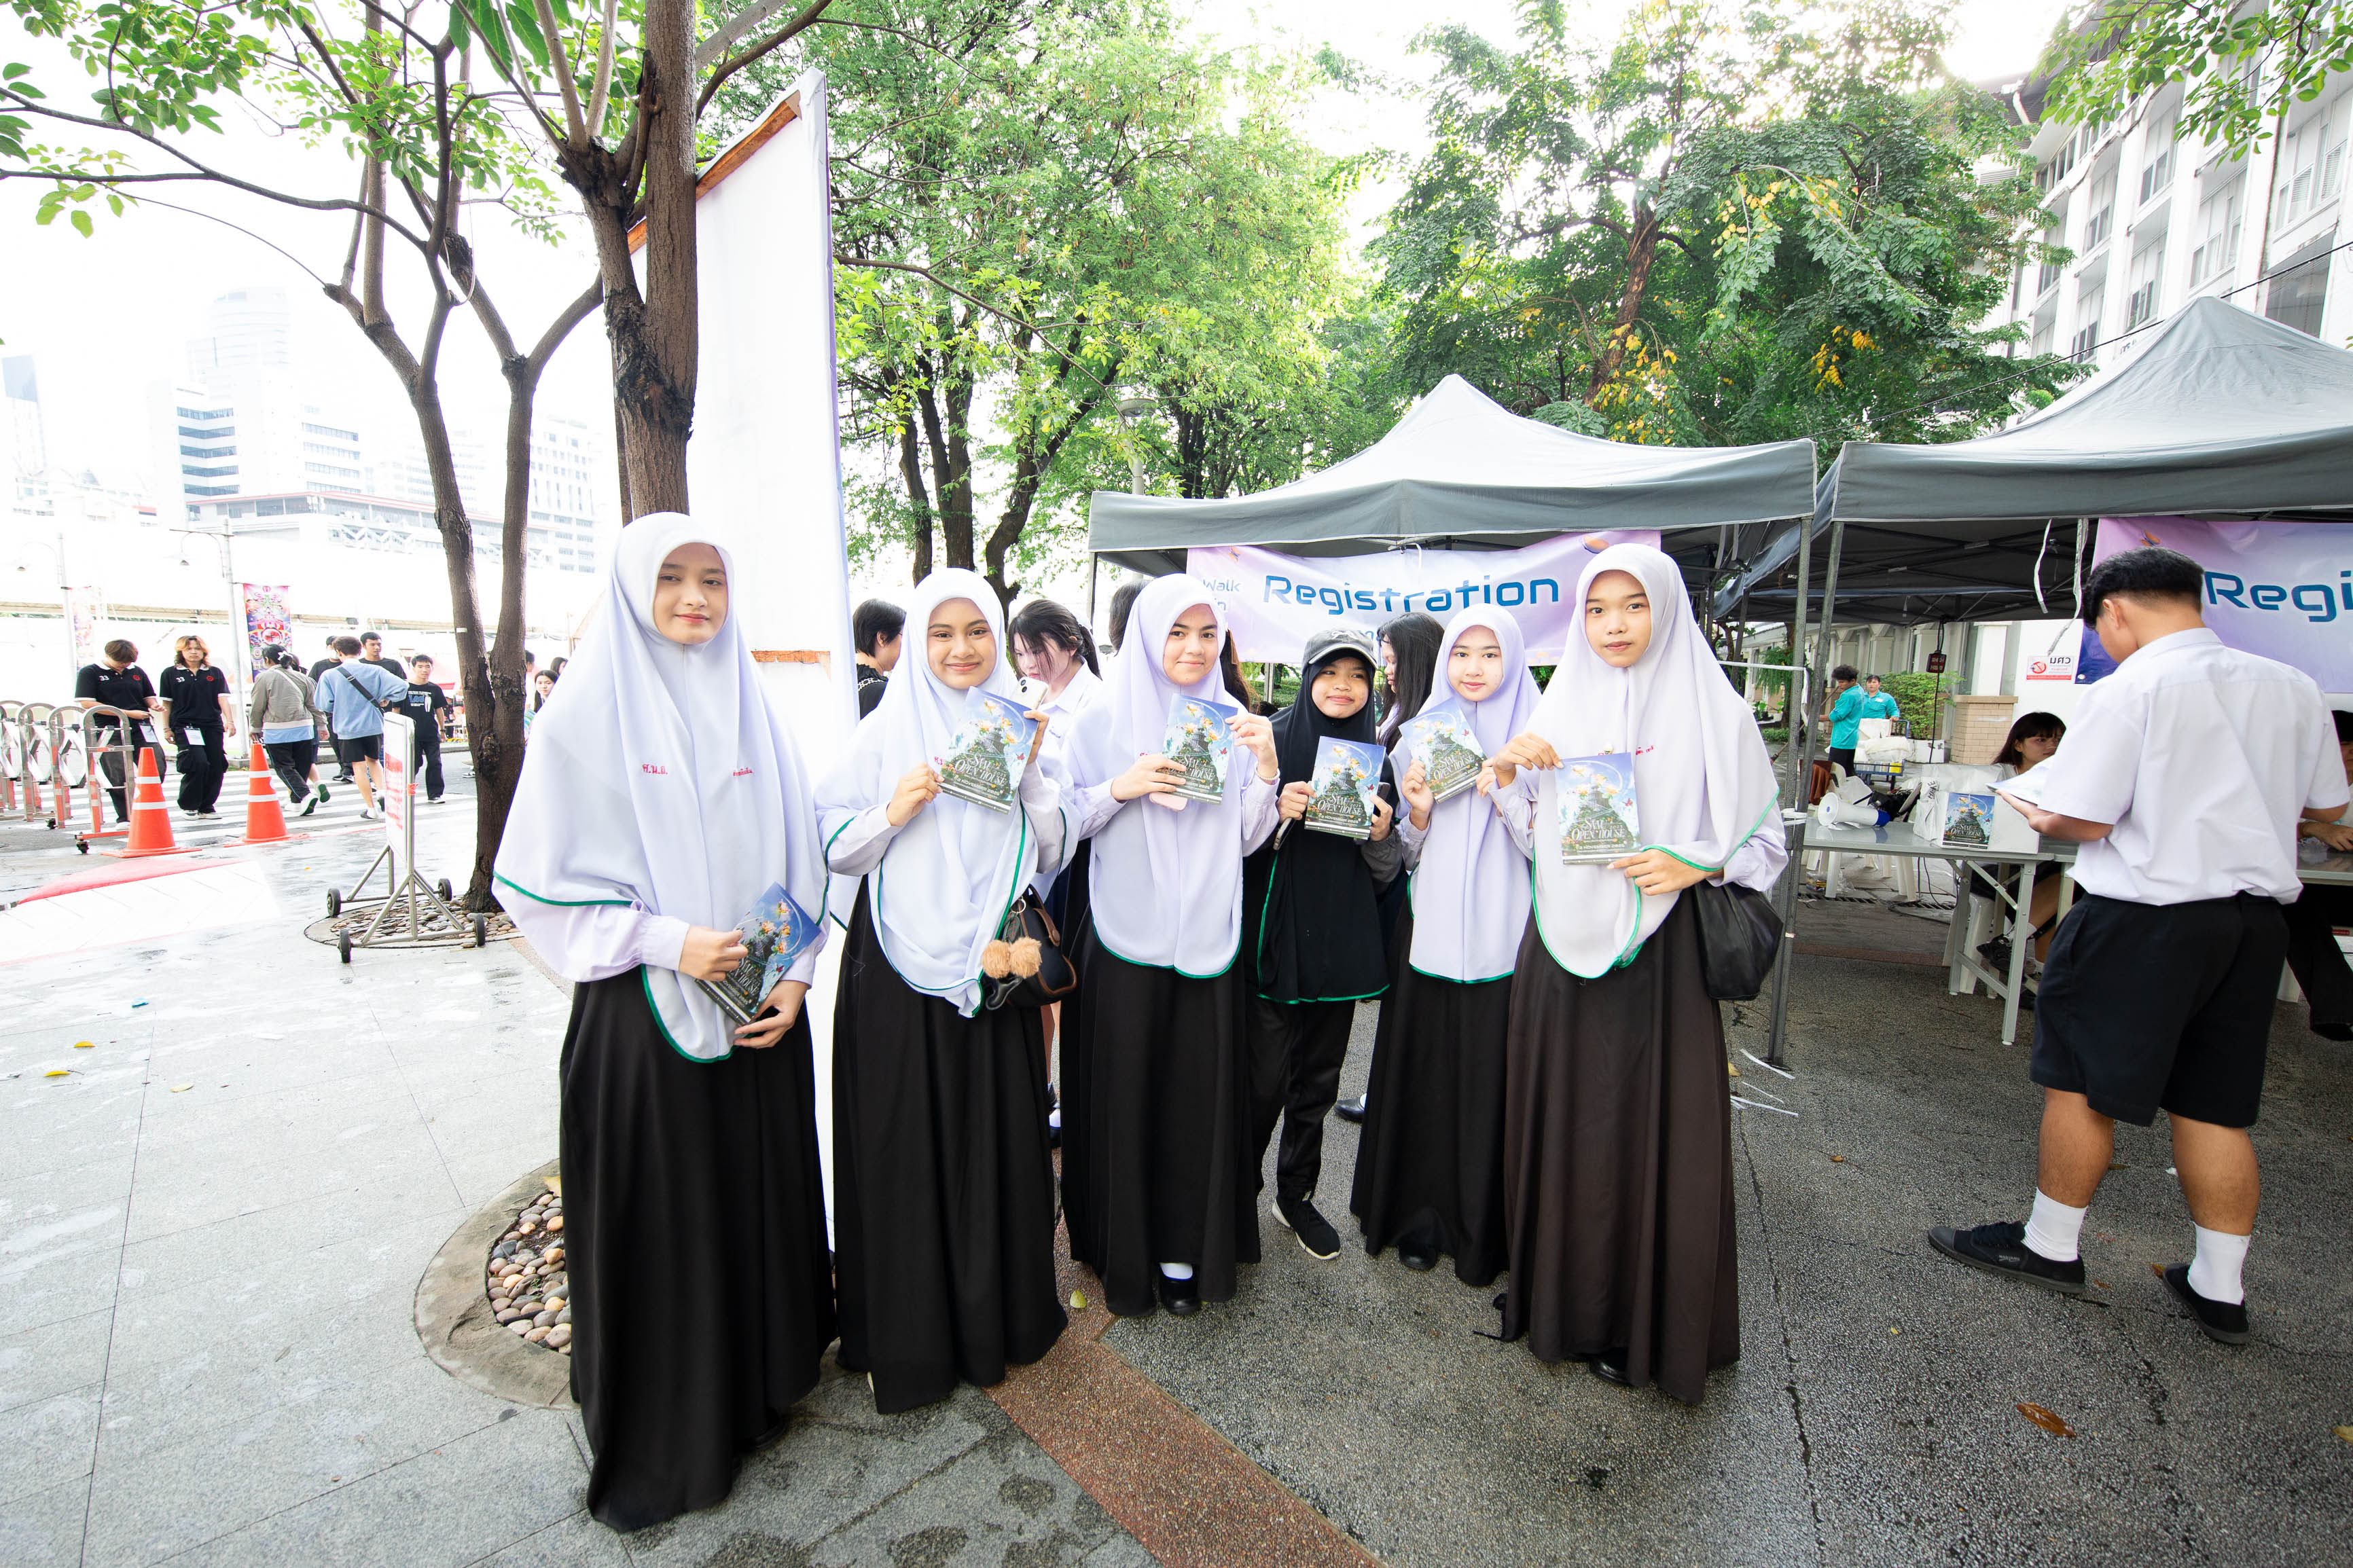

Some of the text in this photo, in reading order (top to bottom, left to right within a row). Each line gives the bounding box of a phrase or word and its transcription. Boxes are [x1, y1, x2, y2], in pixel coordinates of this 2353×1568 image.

[1203, 579, 1241, 591] Walk
[1263, 575, 1559, 615] Registration
[2204, 570, 2353, 622] Regi
[955, 759, 980, 776] OPEN
[980, 771, 1007, 786] HOUSE
[1318, 800, 1338, 812] OPEN
[1340, 805, 1363, 815] HOUSE
[1572, 828, 1625, 841] OPEN HOUSE
